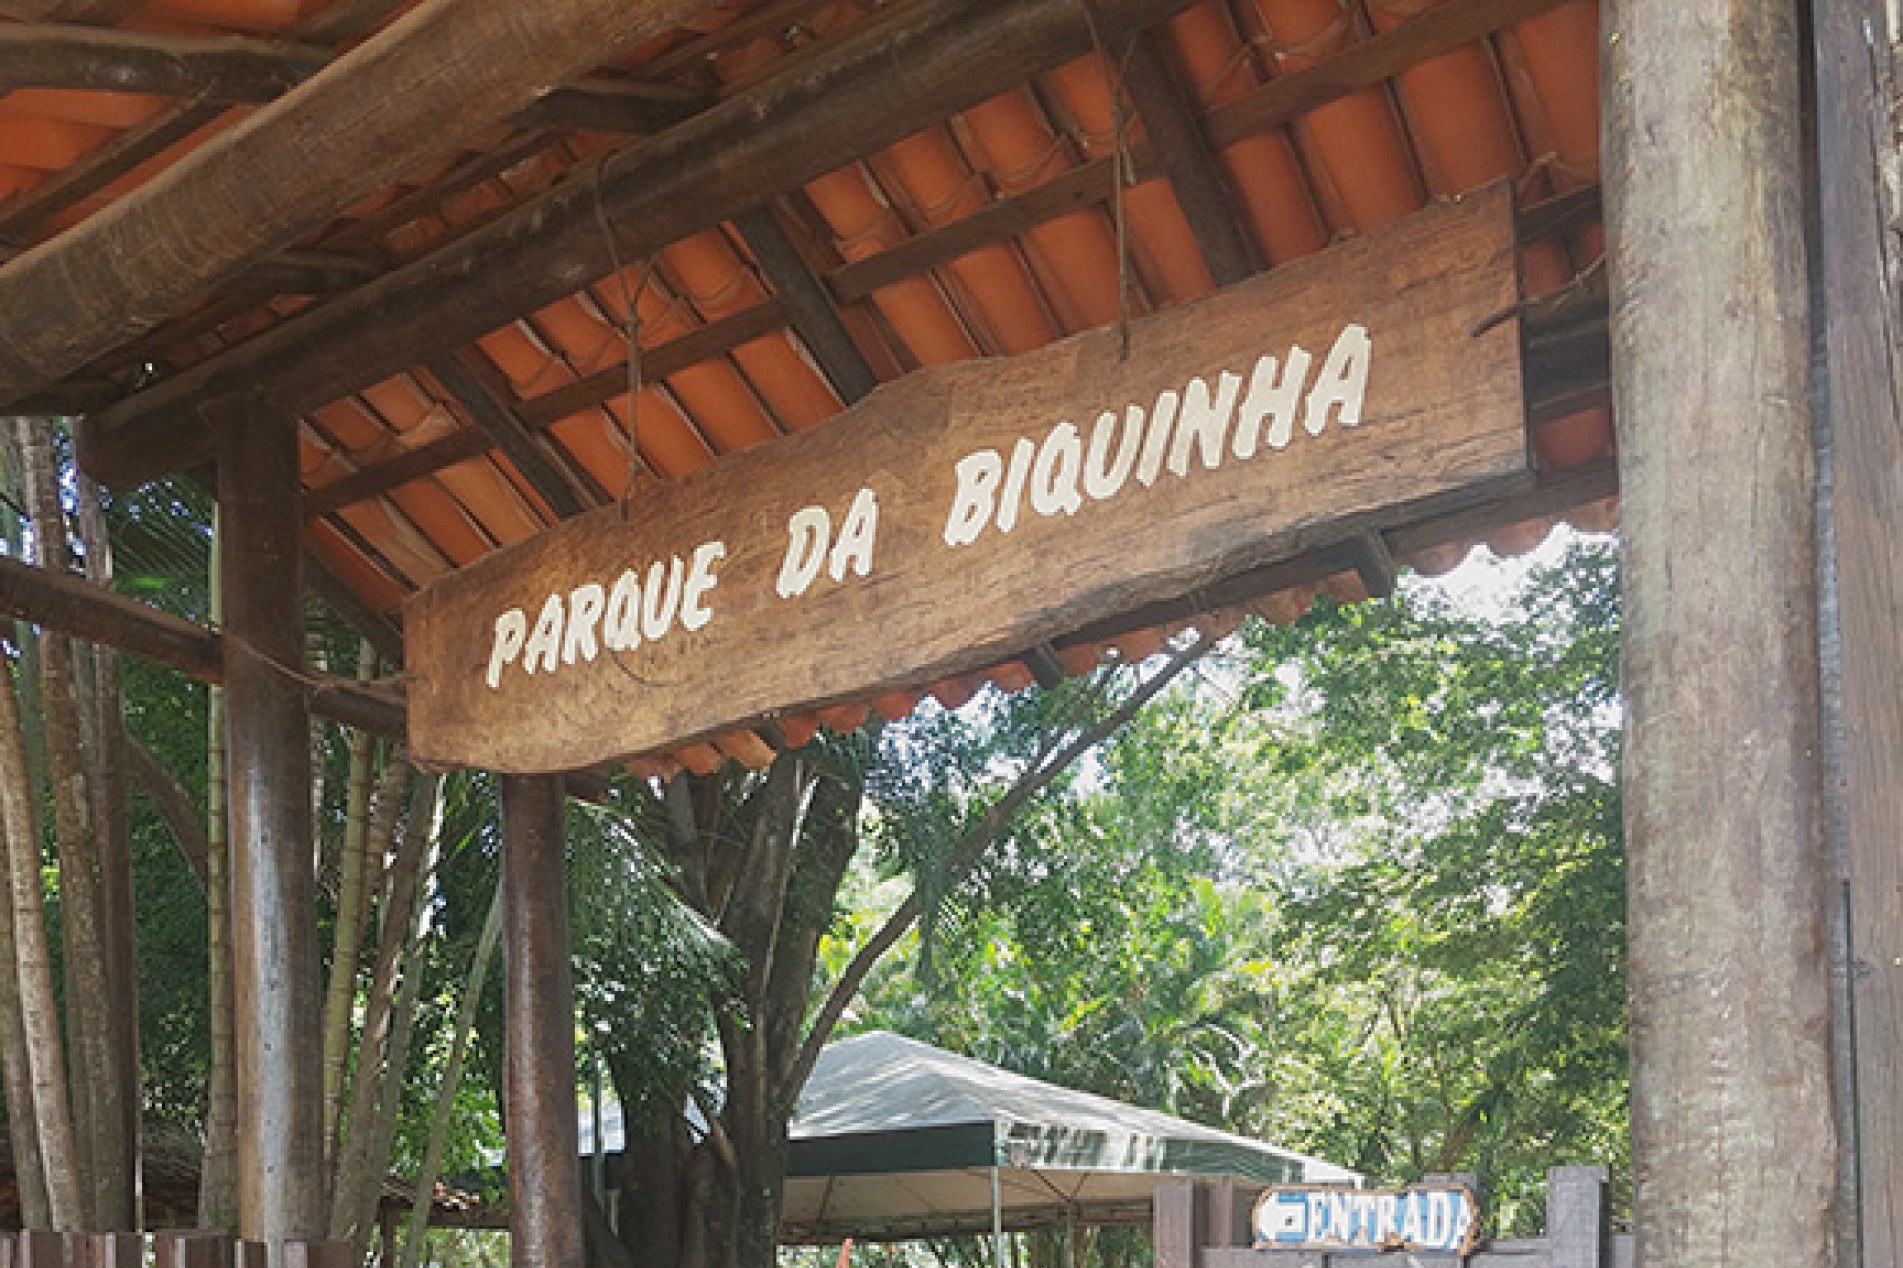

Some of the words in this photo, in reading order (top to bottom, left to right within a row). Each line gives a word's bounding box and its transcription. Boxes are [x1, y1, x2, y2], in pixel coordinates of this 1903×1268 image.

[487, 542, 727, 687] PARQUE
[776, 488, 879, 598] DA
[943, 324, 1371, 548] BIQUINHA
